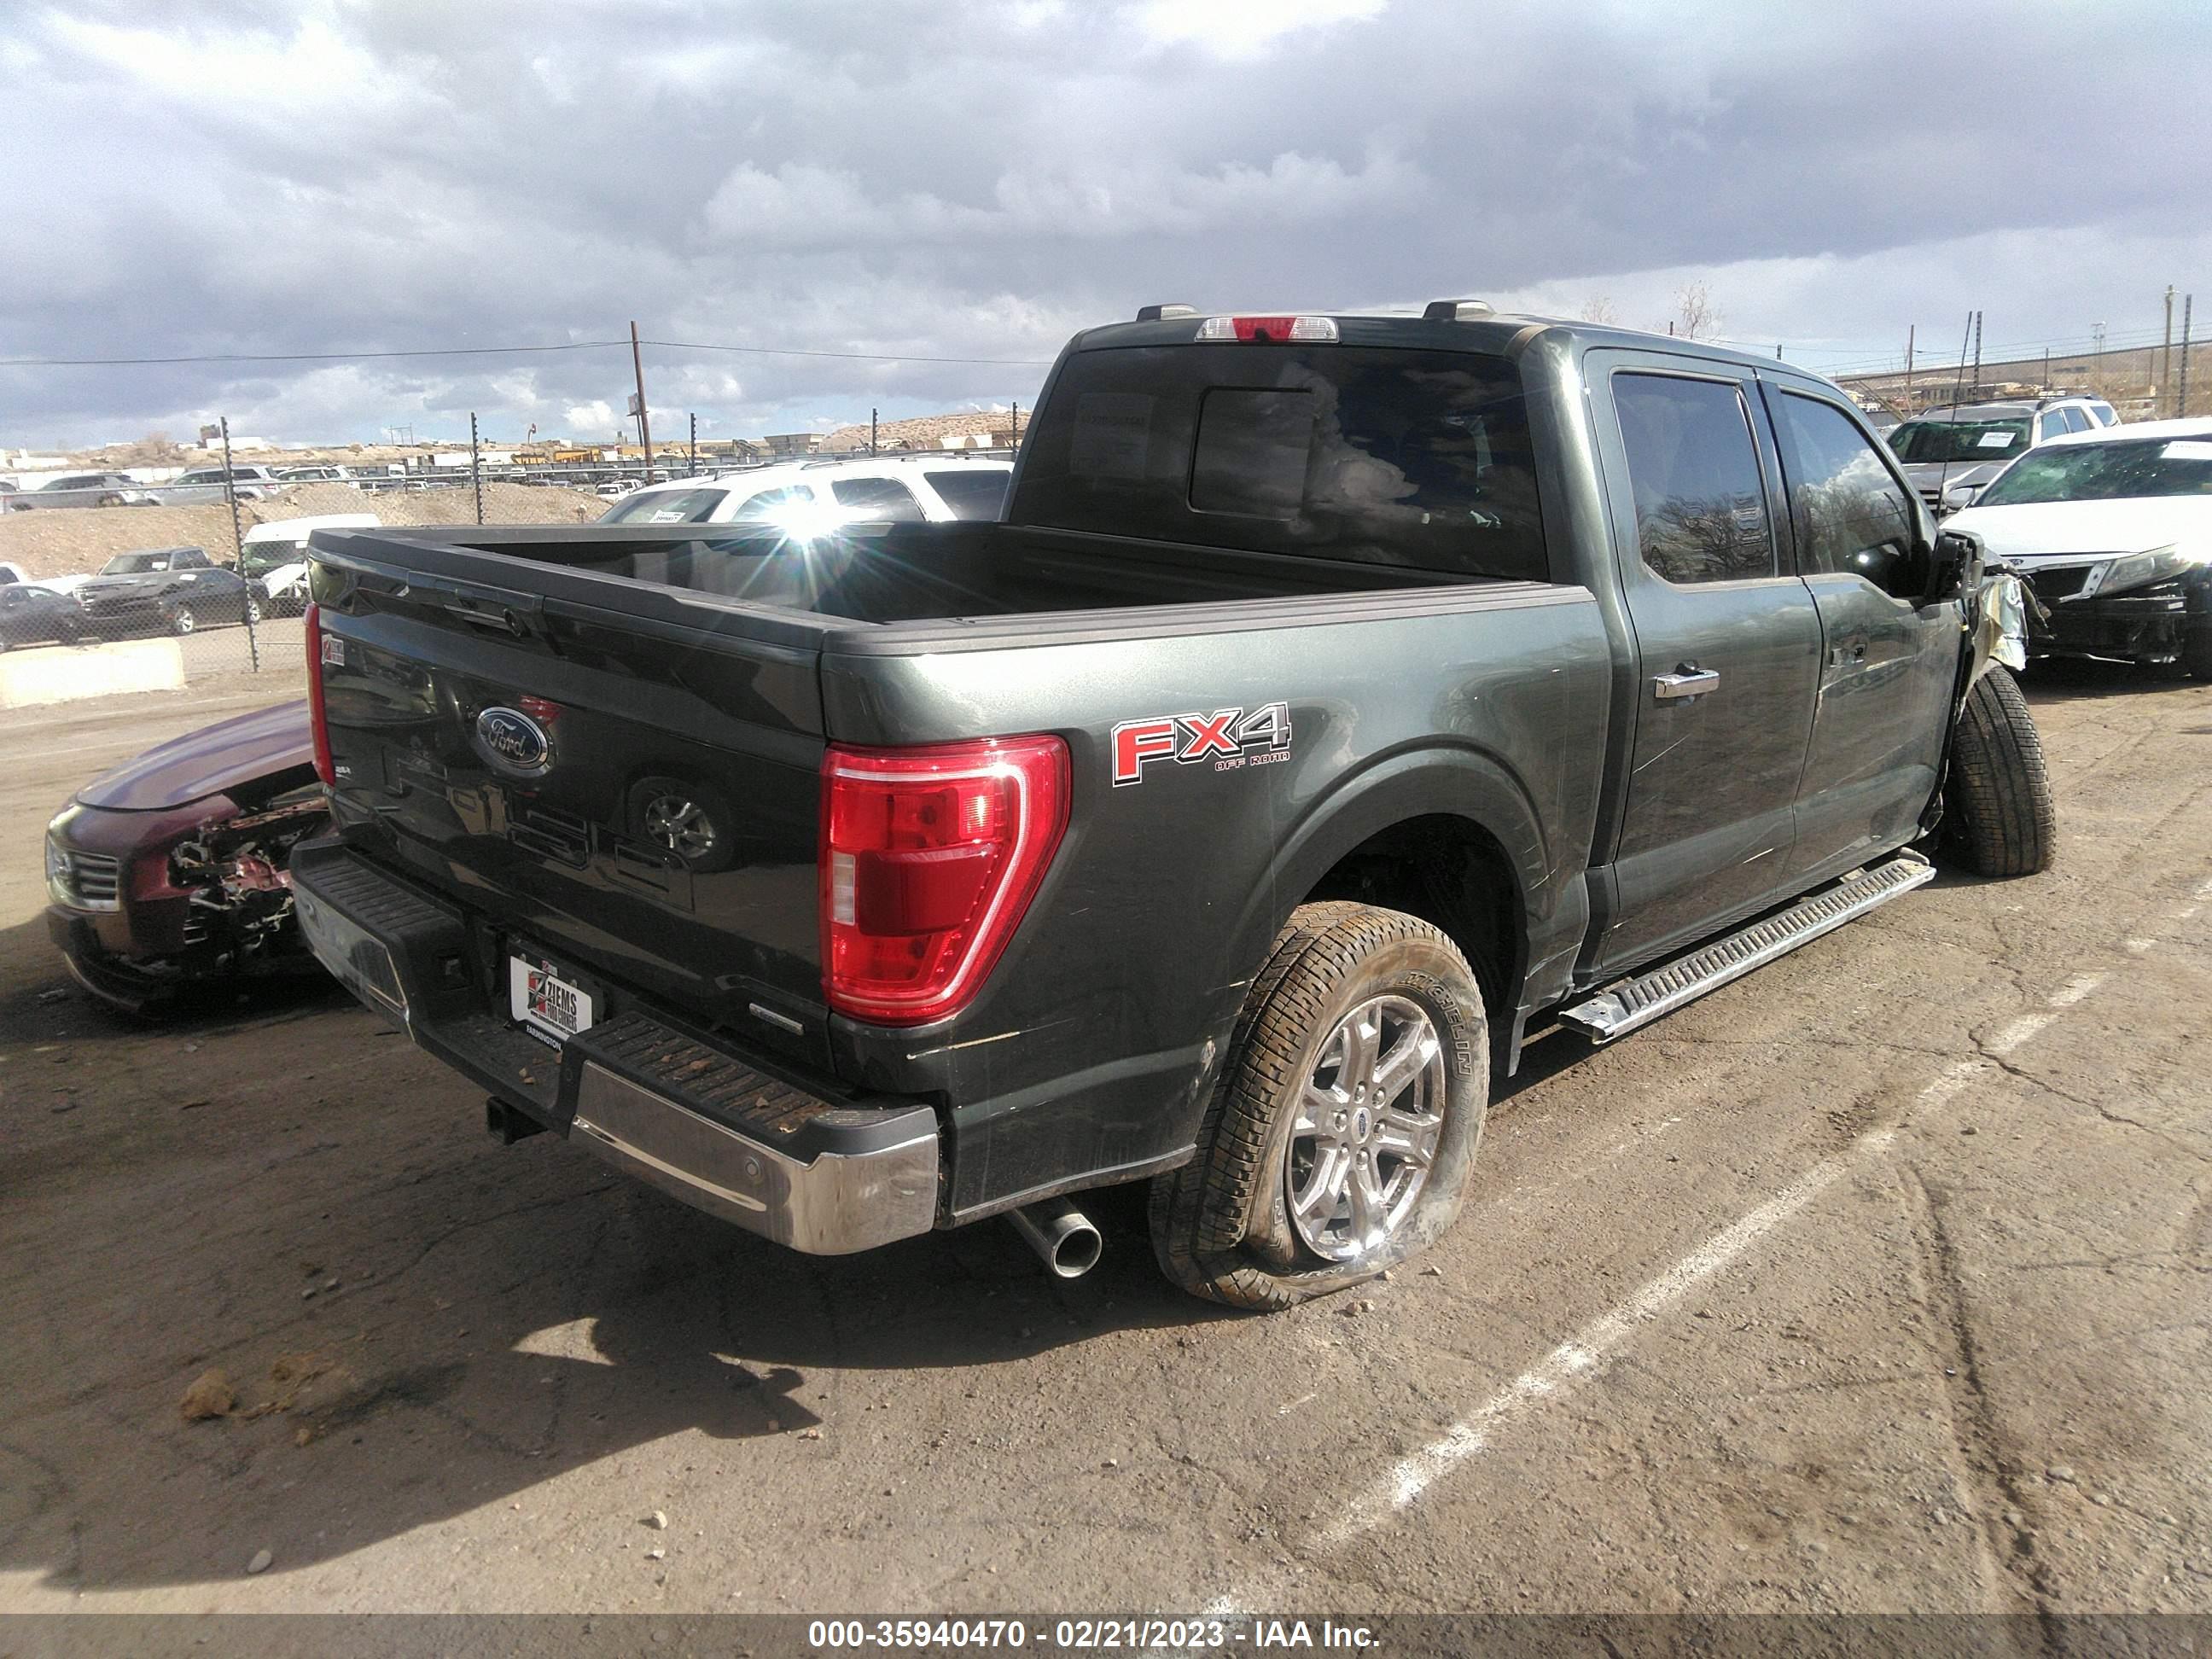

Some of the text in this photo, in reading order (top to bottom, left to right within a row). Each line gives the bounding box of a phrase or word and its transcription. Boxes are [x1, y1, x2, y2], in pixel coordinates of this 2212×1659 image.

[489, 719, 527, 757] Ford
[1111, 701, 1292, 788] FX4
[1215, 751, 1290, 771] OFF ROAD
[546, 981, 578, 1016] ZIEMS
[1393, 972, 1472, 1076] MICHELIN
